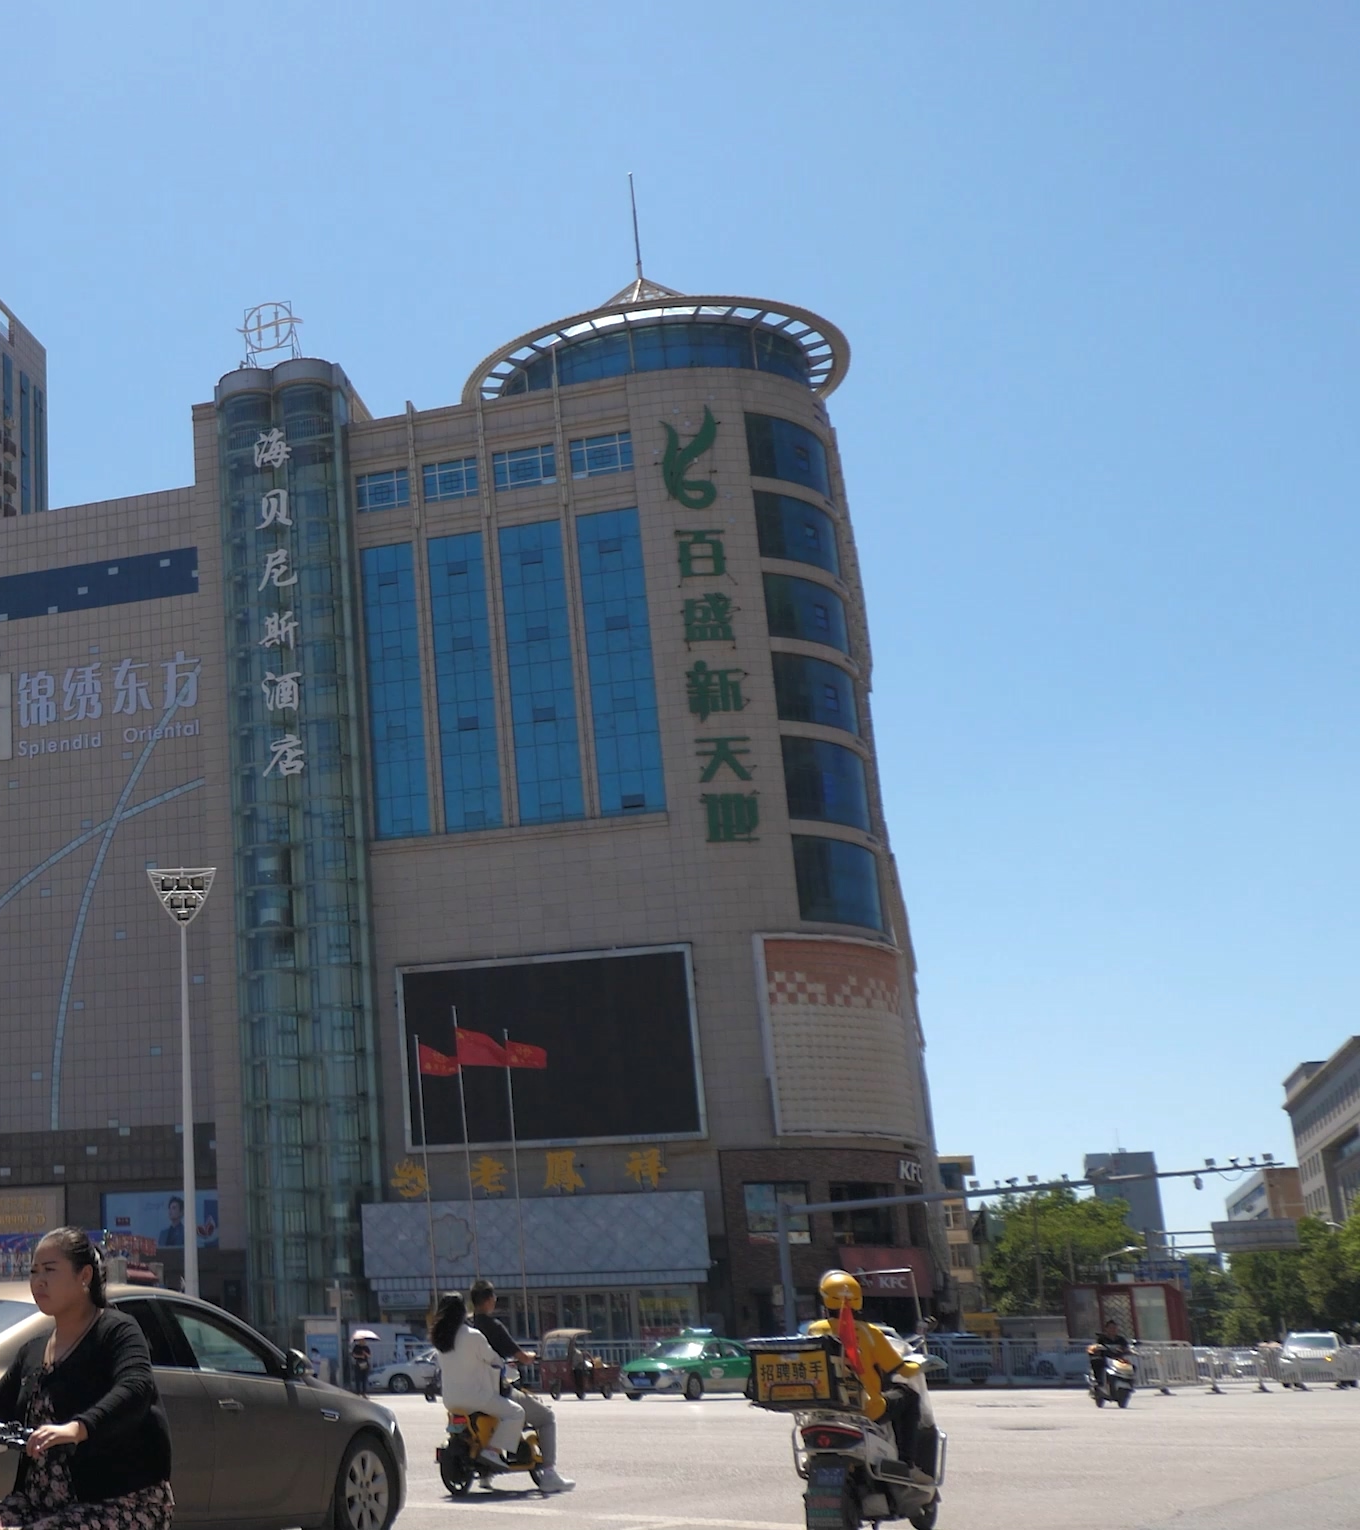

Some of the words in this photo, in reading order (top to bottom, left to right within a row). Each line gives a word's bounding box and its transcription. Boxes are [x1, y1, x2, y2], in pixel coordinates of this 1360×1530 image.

[253, 426, 306, 779] 海贝尼斯酒店
[16, 650, 203, 729] 锦绣东方
[675, 528, 760, 844] 百盛新天地
[17, 731, 103, 760] Splendid
[122, 719, 201, 745] Oriental
[899, 1159, 923, 1184] KFC
[879, 1276, 909, 1290] KFC
[760, 1360, 825, 1383] 招聘骑手
